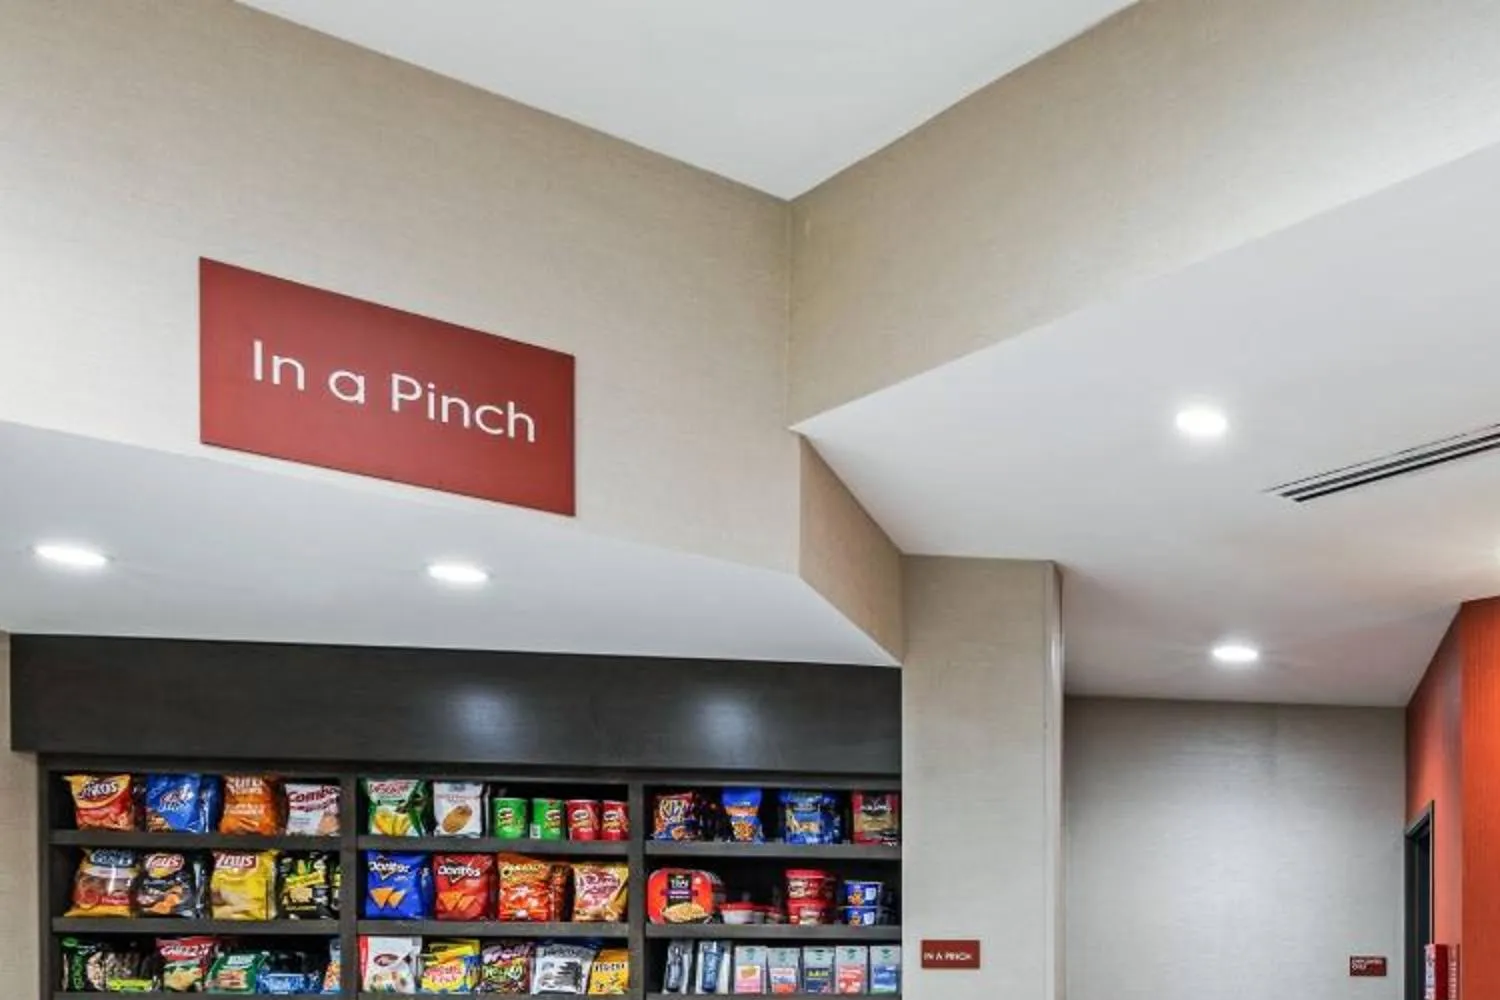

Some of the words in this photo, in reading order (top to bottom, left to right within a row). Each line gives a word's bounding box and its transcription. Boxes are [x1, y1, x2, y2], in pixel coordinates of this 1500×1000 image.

[252, 339, 305, 391] In
[327, 369, 366, 404] a
[390, 372, 536, 443] Pinch
[437, 864, 481, 878] Doritos
